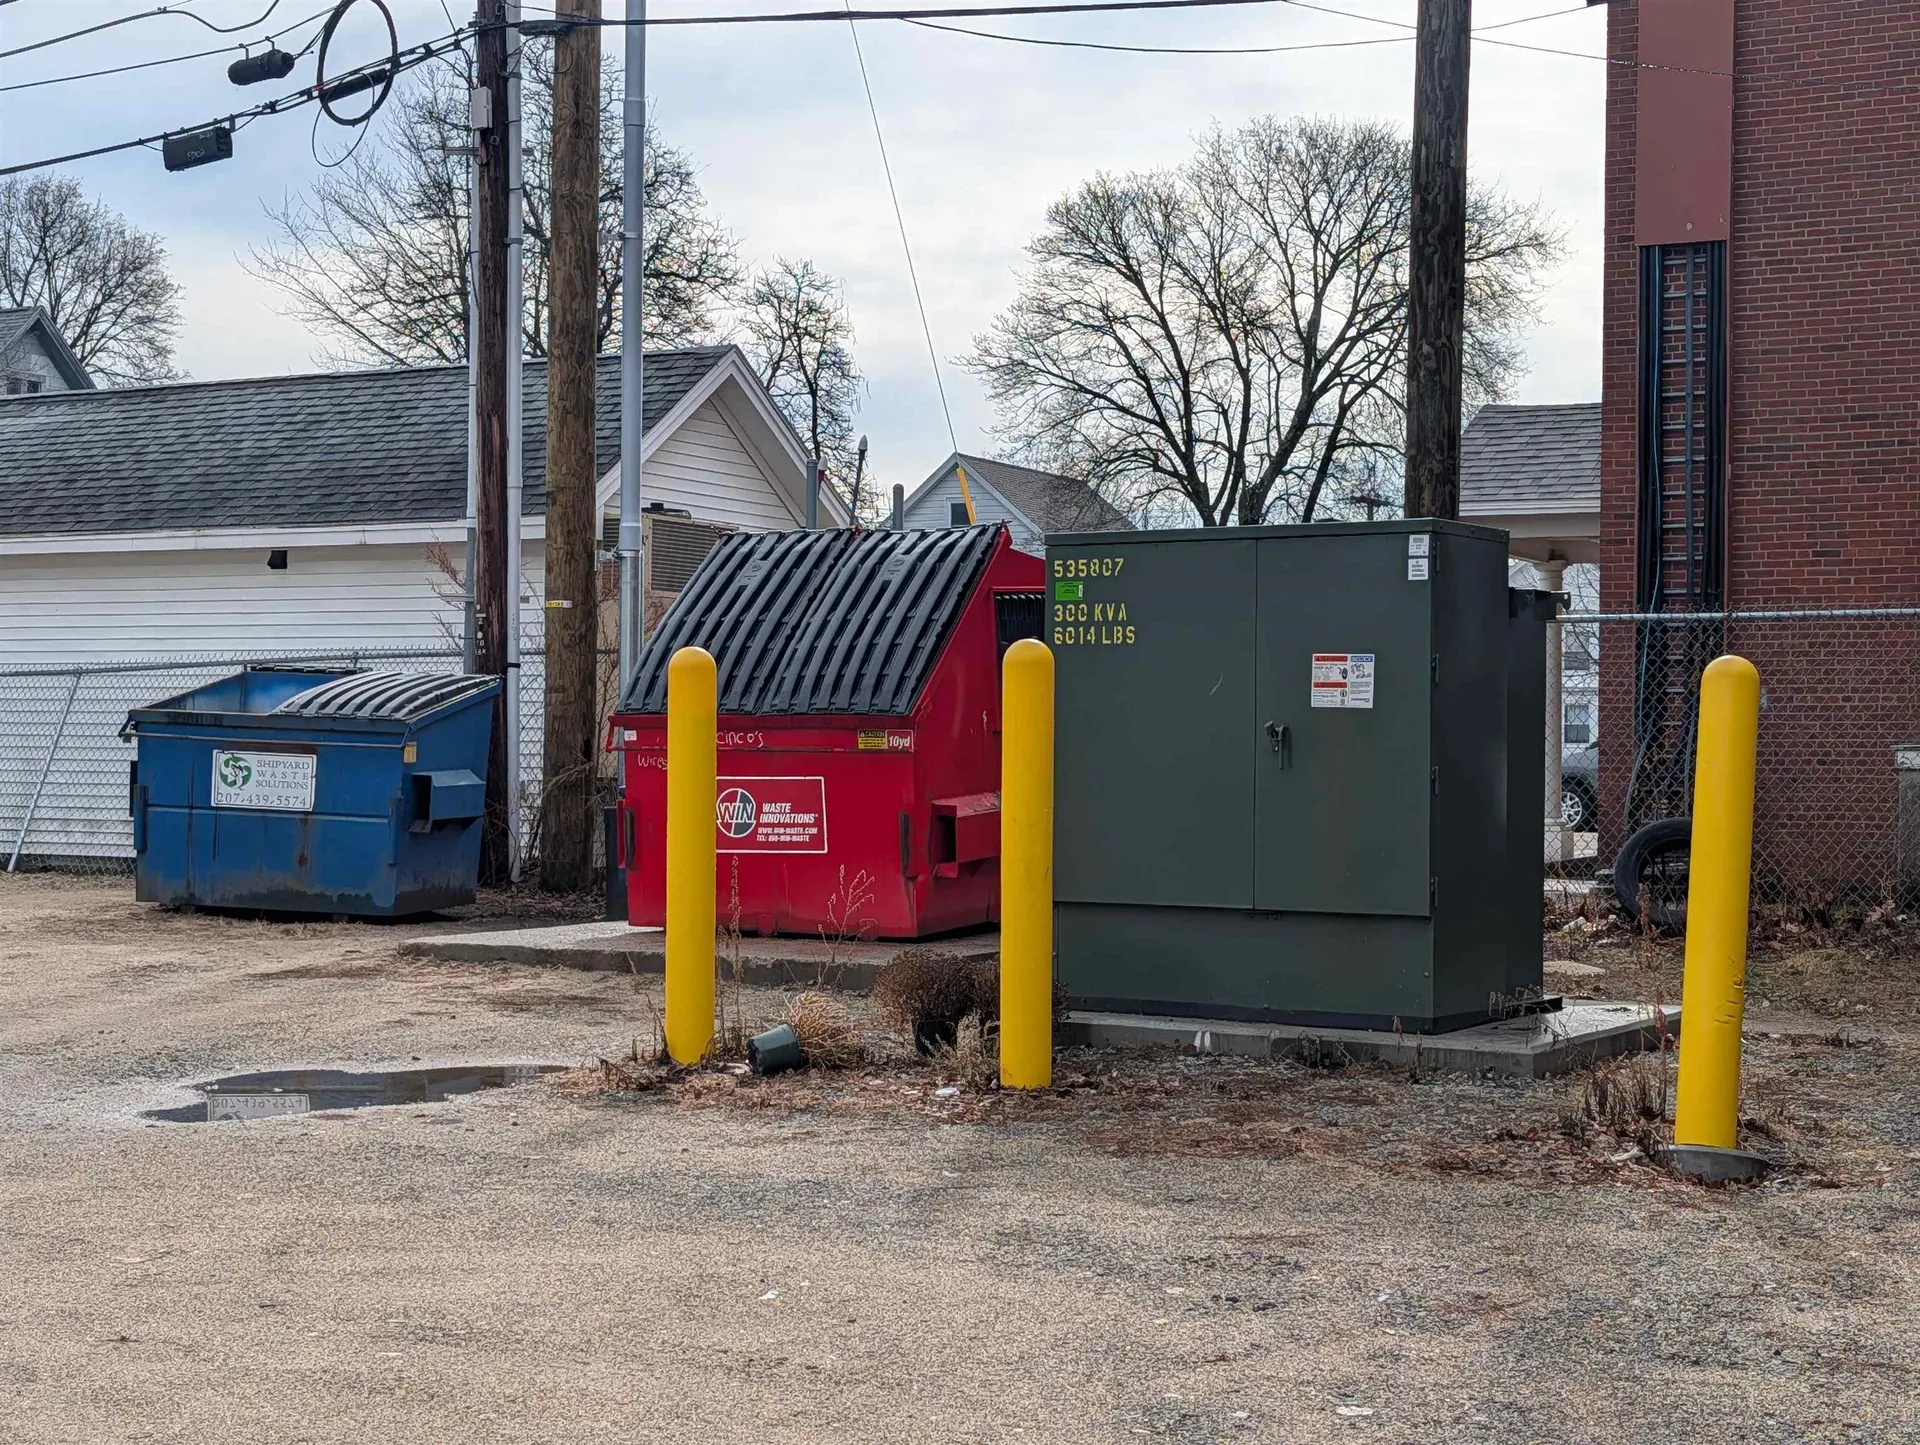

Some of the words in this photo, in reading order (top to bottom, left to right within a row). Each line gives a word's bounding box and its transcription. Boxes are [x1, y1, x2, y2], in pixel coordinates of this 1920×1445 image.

[1054, 558, 1124, 577] 535807
[1054, 604, 1087, 621] 300
[1094, 603, 1127, 621] KVA
[1054, 626, 1095, 645] 6014
[1102, 626, 1135, 644] LBS
[888, 735, 911, 750] 10yd
[256, 759, 310, 770] SHIPYARD
[257, 770, 309, 780] WASTE
[256, 780, 309, 790] SOLUTIONS
[718, 802, 756, 823] WIN
[762, 802, 791, 813] WASTE
